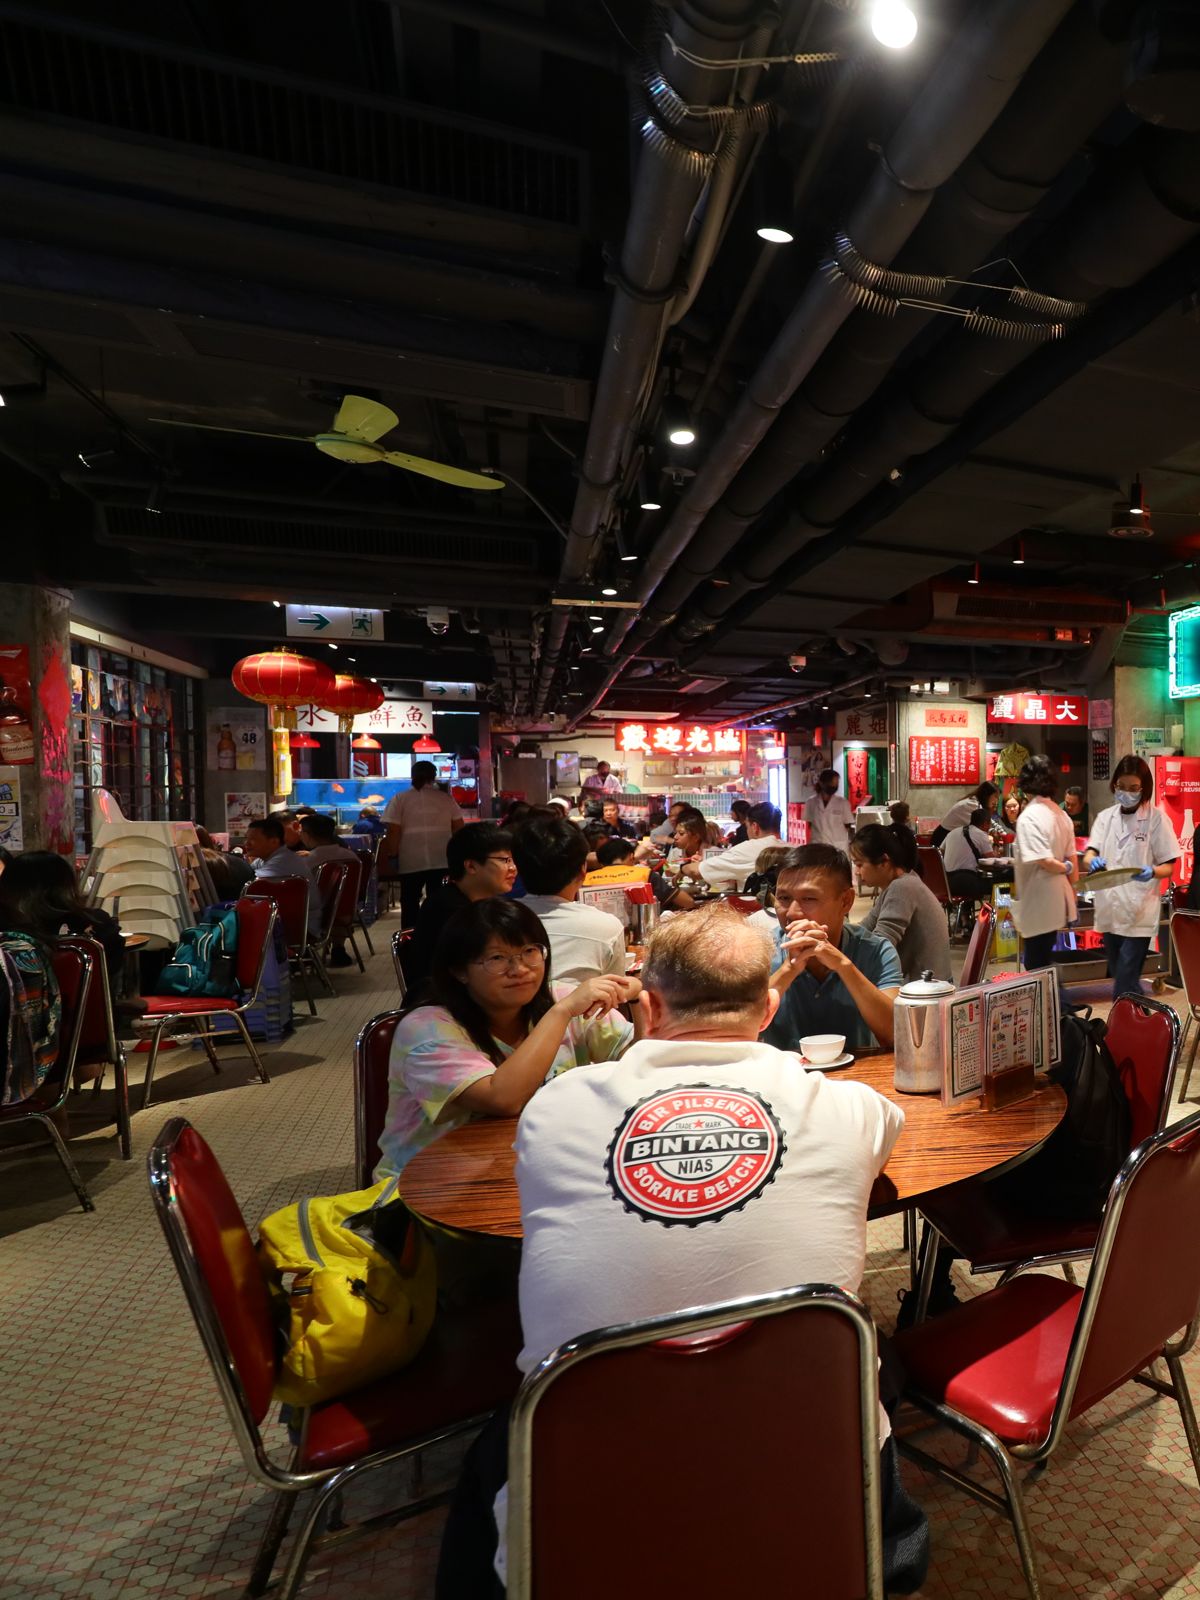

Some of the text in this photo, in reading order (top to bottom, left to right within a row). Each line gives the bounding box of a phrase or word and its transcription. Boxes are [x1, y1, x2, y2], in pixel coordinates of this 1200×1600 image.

[638, 1097, 757, 1132] BIR PILSENER
[631, 1133, 761, 1159] BINTANG
[633, 1157, 757, 1203] SORAKE BEACH
[678, 1159, 713, 1175] NIAS
